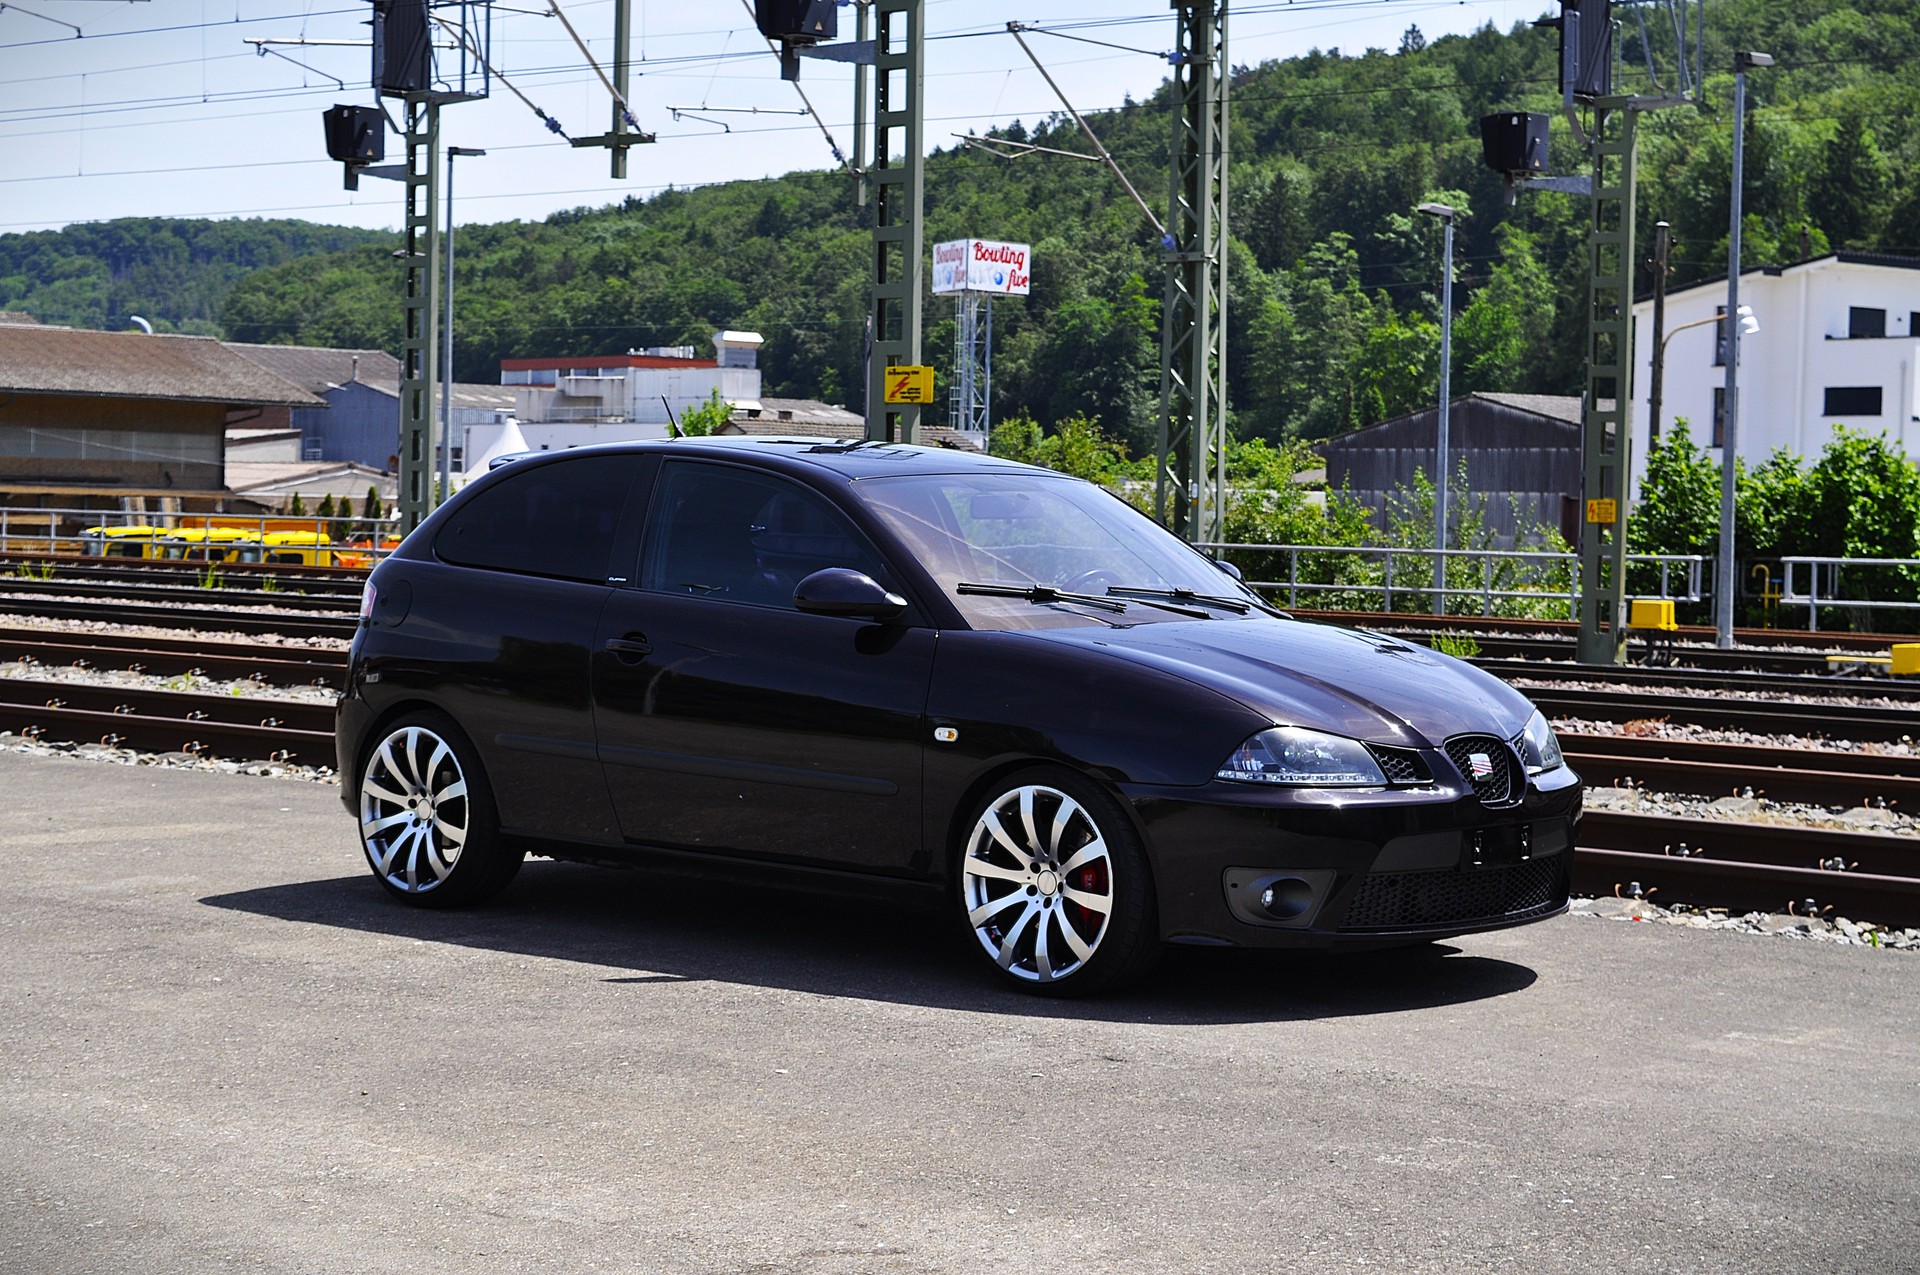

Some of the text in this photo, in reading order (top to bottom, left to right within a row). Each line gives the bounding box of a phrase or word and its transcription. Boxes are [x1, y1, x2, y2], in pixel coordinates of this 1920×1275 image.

[936, 244, 963, 266] Bowling
[973, 241, 1025, 270] Bowling
[1006, 268, 1029, 291] five
